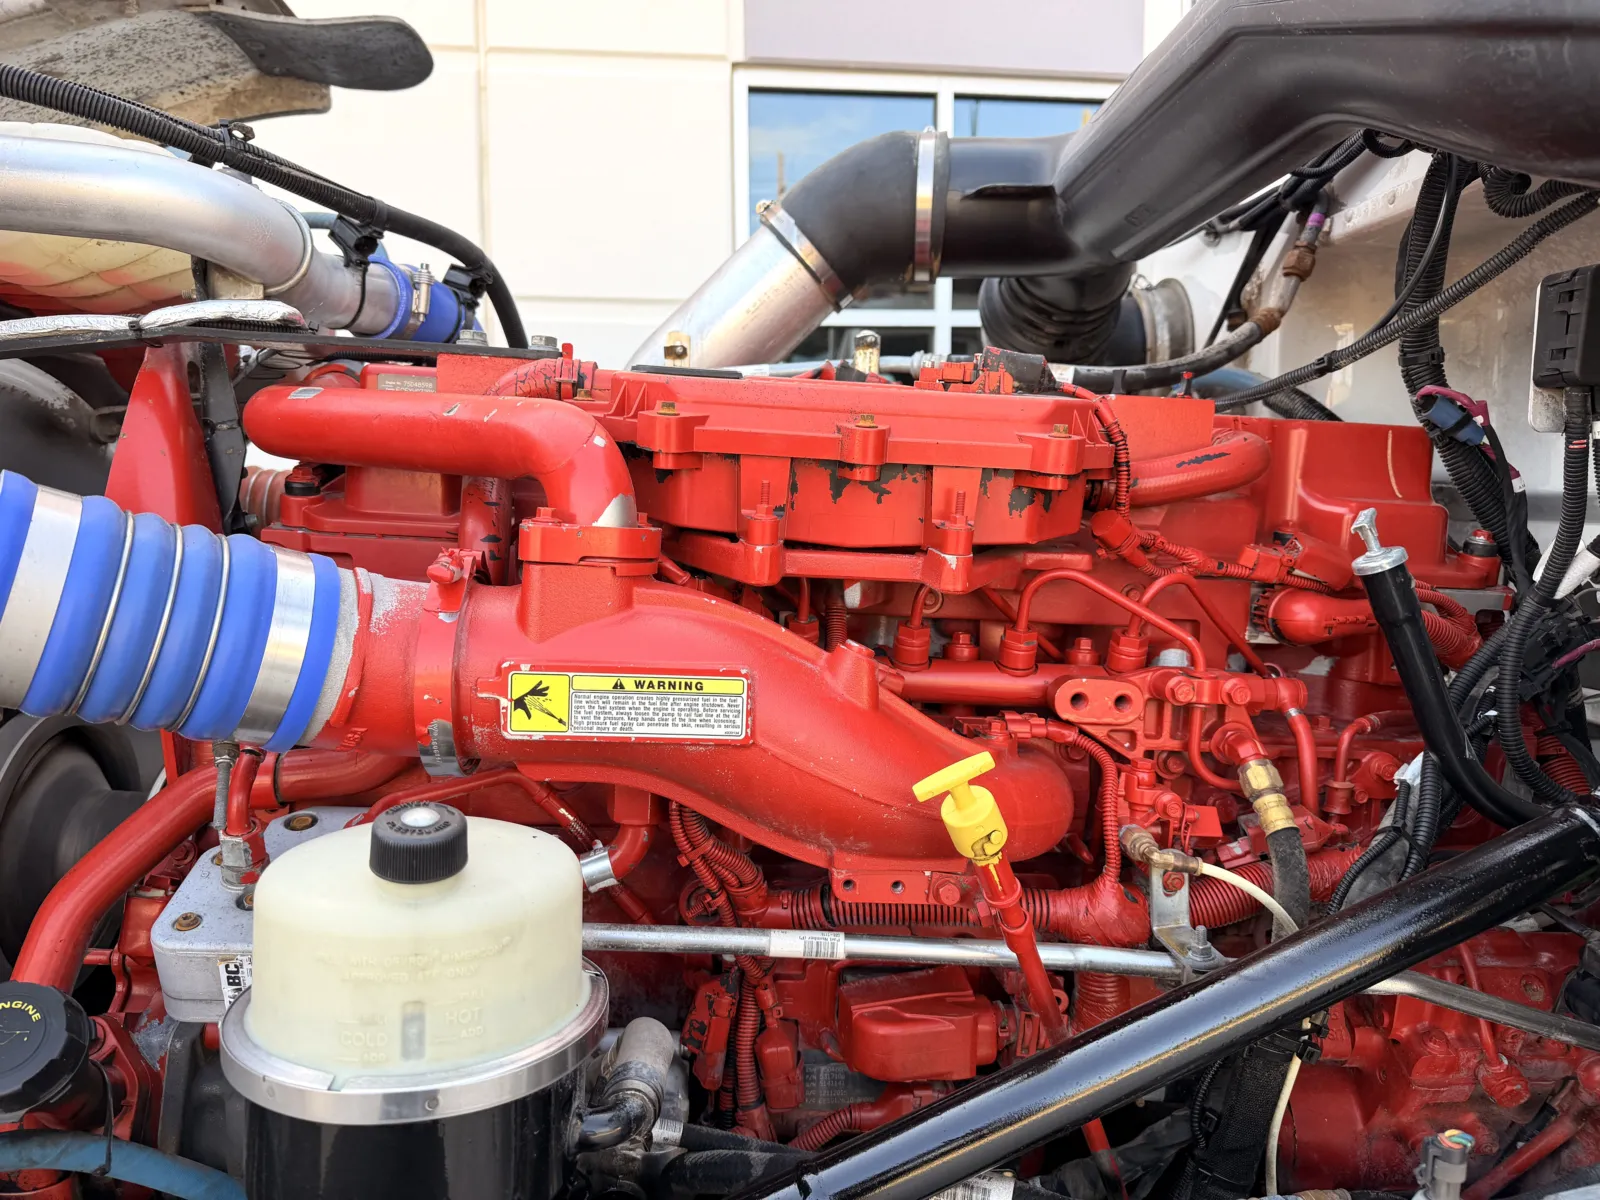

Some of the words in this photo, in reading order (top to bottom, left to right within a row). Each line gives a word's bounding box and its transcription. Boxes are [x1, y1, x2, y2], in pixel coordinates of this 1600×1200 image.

[634, 680, 704, 691] WARNING
[0, 1000, 41, 1023] NGINE
[444, 1008, 483, 1024] HOT
[340, 1030, 388, 1047] COLD
[460, 1026, 484, 1038] ADD
